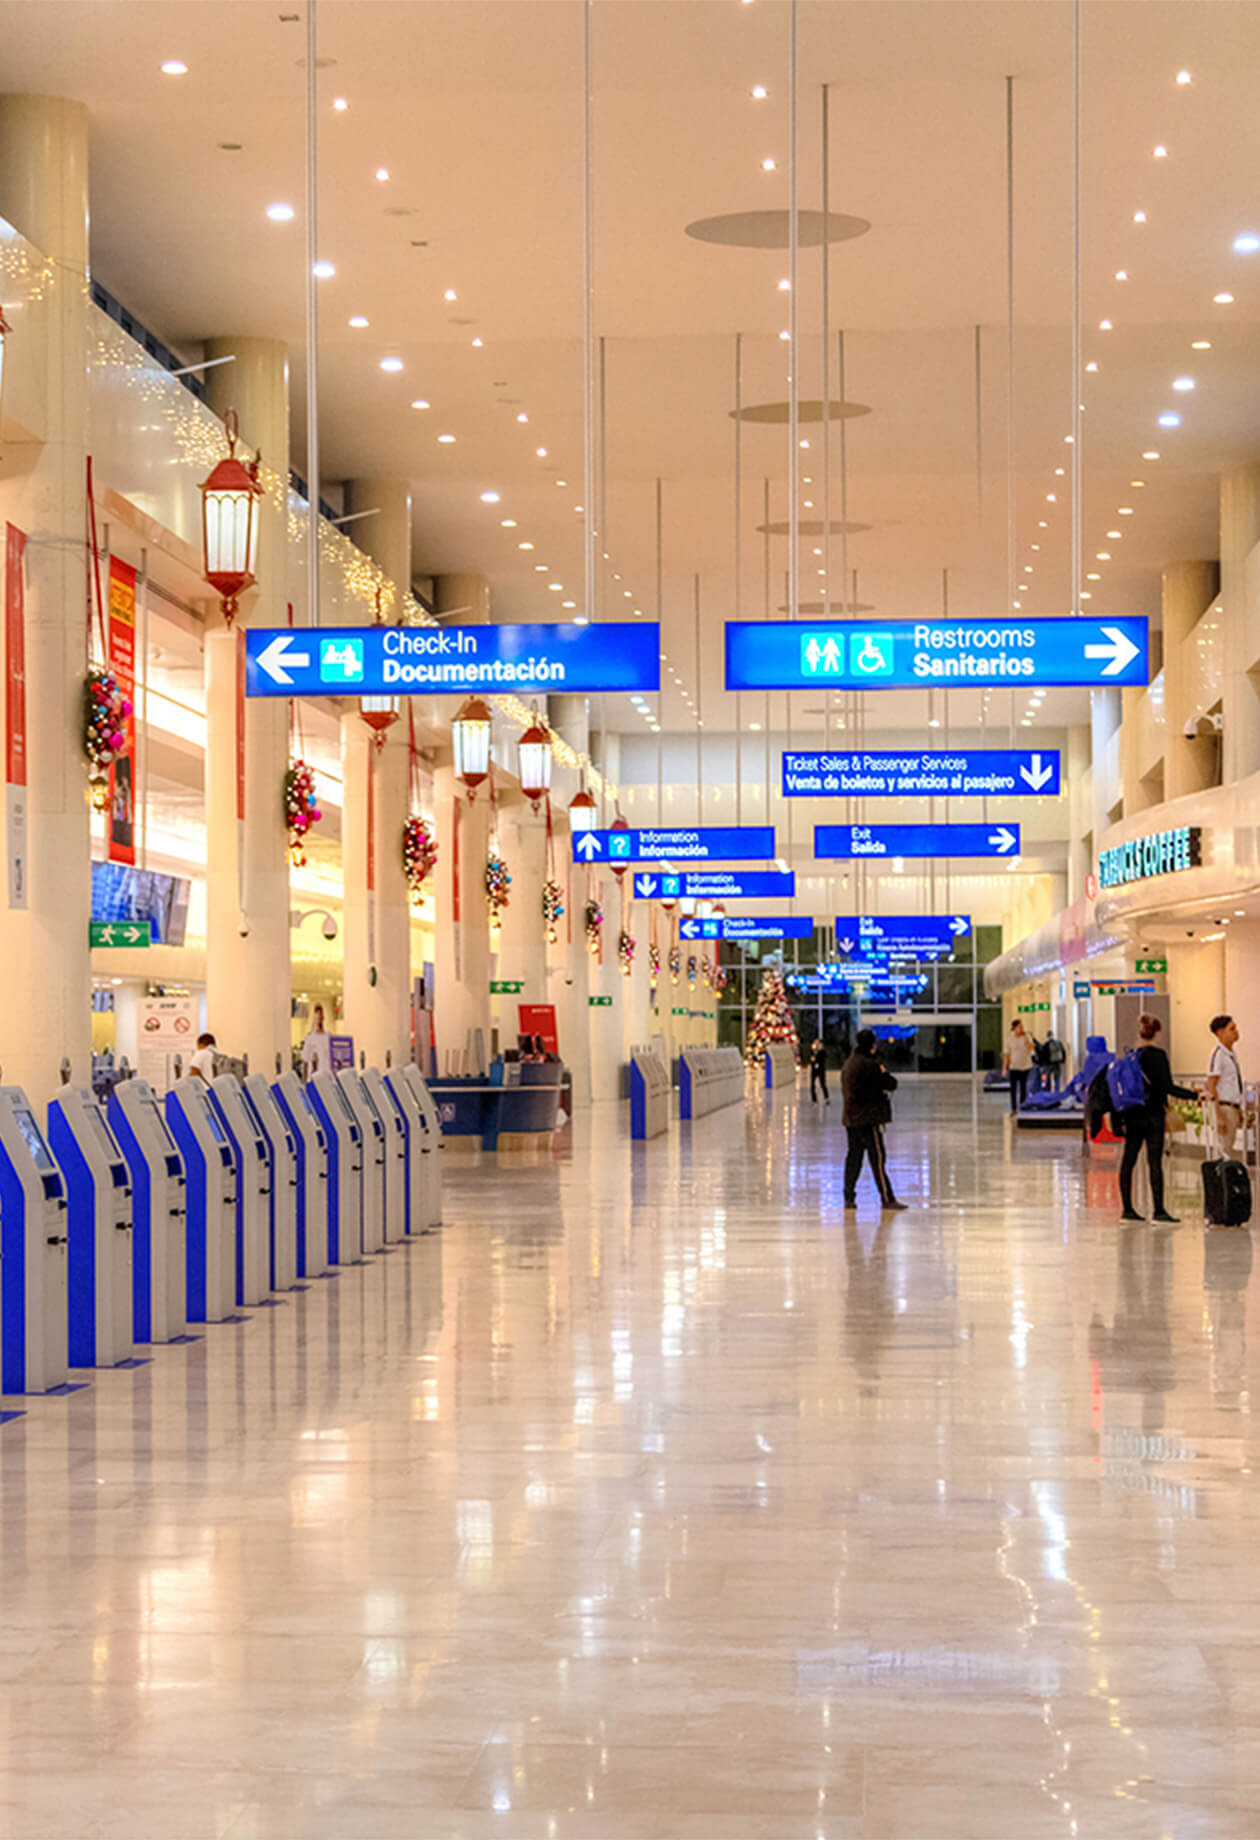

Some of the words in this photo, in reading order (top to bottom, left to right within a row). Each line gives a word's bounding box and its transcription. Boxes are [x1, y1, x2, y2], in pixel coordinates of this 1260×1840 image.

[382, 630, 478, 655] Check-In
[913, 624, 1036, 649] Restrooms
[383, 657, 566, 684] Documentación
[912, 652, 1036, 678] Sanitarios
[786, 755, 819, 772] Ticket
[820, 755, 850, 772] Sales
[851, 755, 862, 771] &
[863, 755, 920, 774] Passenger
[921, 754, 968, 771] Services
[785, 774, 822, 790] Venta
[823, 774, 839, 790] de
[840, 774, 886, 790] boletos
[887, 777, 896, 793] y
[897, 773, 949, 790] servicios
[950, 773, 963, 789] al
[963, 773, 1015, 793] pasajero
[639, 831, 699, 844] Information
[850, 826, 872, 840] Exit
[639, 844, 709, 857] Información
[850, 841, 887, 855] Salida
[1144, 826, 1192, 878] COFFEE
